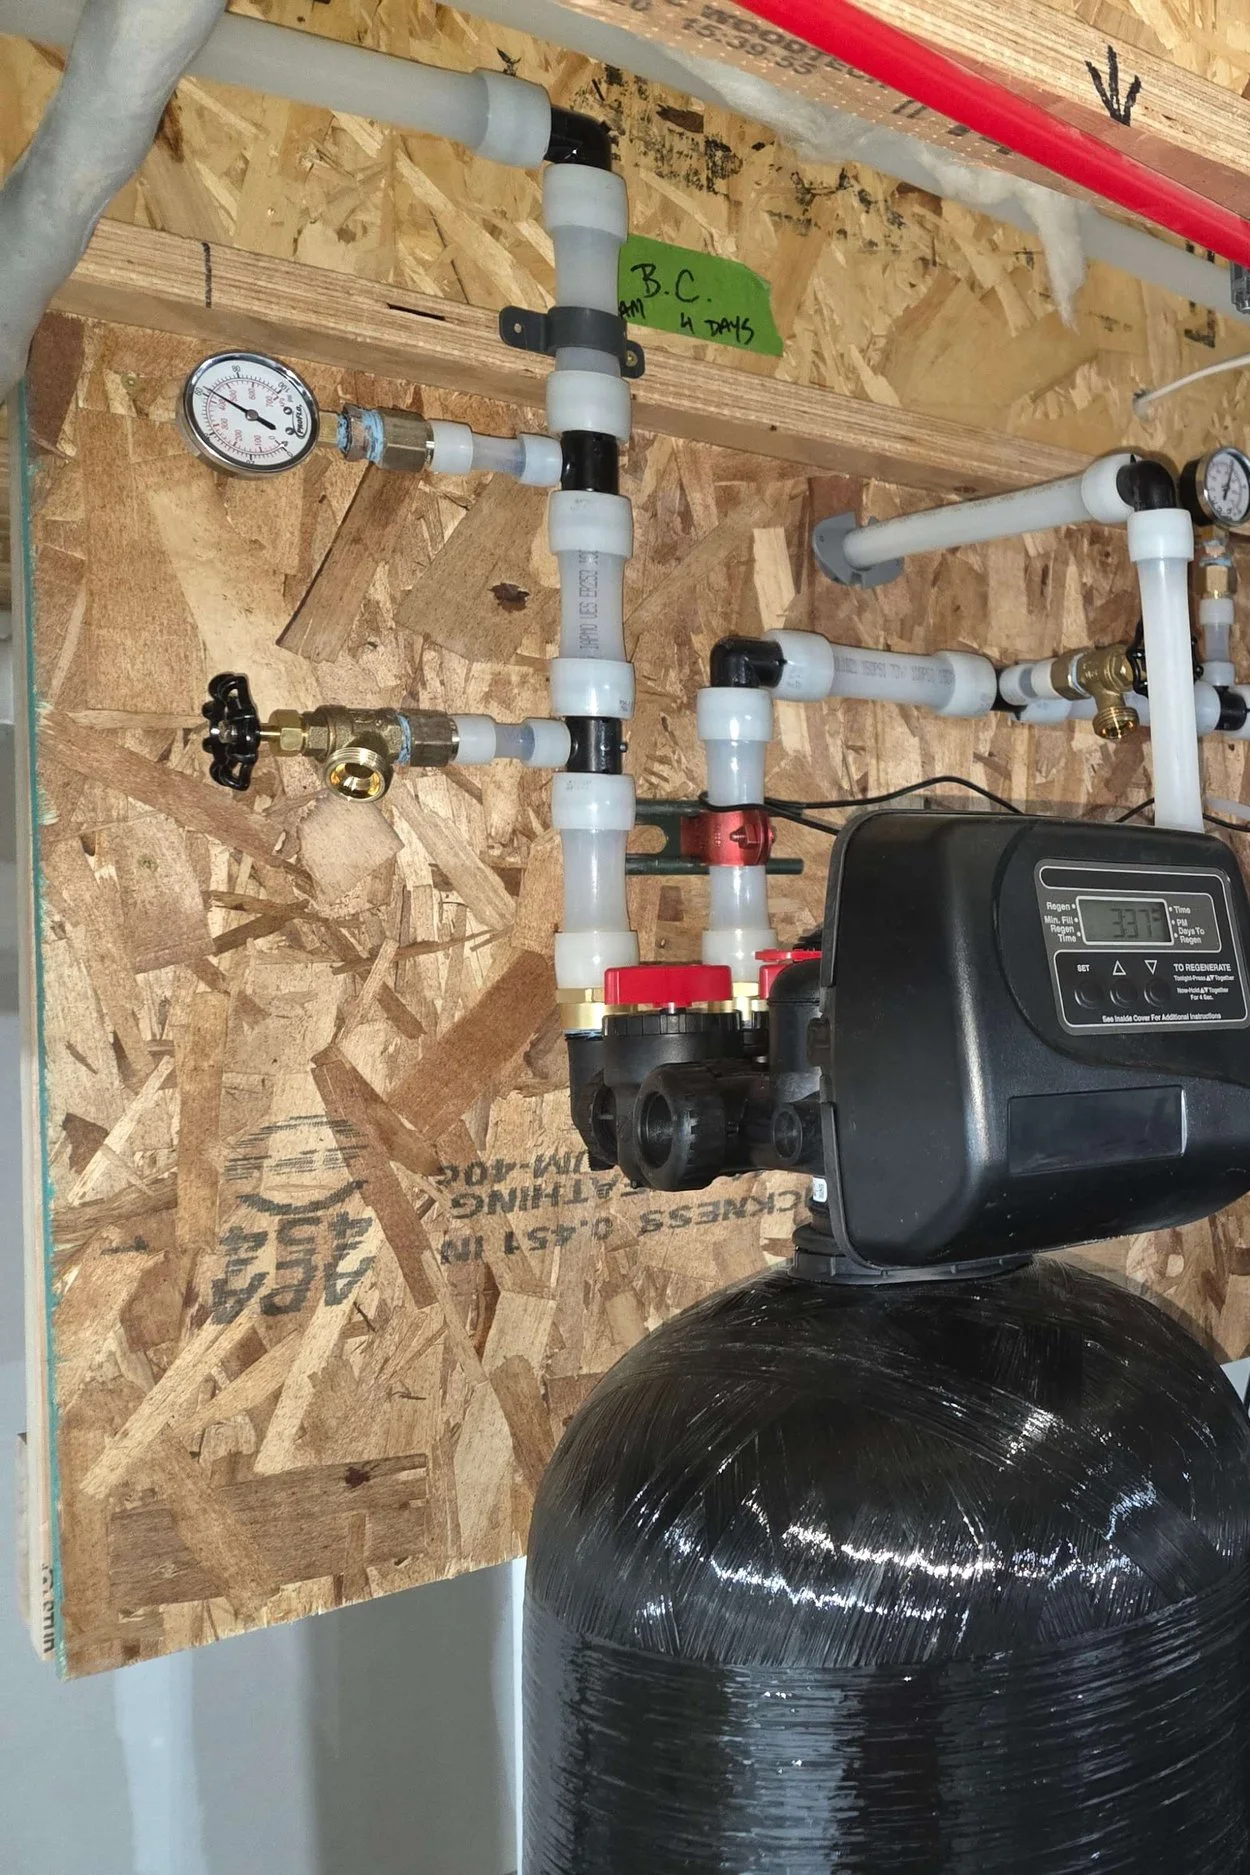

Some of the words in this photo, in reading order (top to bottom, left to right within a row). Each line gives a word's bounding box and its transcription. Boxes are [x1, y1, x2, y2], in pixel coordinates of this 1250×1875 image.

[631, 263, 712, 302] B.C.
[680, 312, 695, 333] 4
[704, 315, 755, 345] DAYS
[1046, 902, 1071, 912] Regen
[1173, 905, 1191, 914] Time
[1044, 915, 1061, 924] Min.
[1061, 916, 1074, 925] Fill
[1050, 924, 1075, 934] Regen
[1178, 927, 1195, 936] Days
[1195, 927, 1205, 935] To
[1057, 933, 1077, 943] Time
[1180, 936, 1202, 945] Regen
[1077, 964, 1090, 972] SET
[1173, 963, 1184, 972] TO
[1185, 963, 1232, 972] REGENERATE
[1114, 1014, 1132, 1022] Inside
[1132, 1014, 1150, 1022] Cover
[1150, 1013, 1161, 1021] For
[1161, 1013, 1189, 1021] Additional
[1189, 1012, 1222, 1020] Instructions
[503, 1217, 614, 1255] 0.451
[440, 1235, 485, 1266] IN
[209, 1257, 377, 1327] APA
